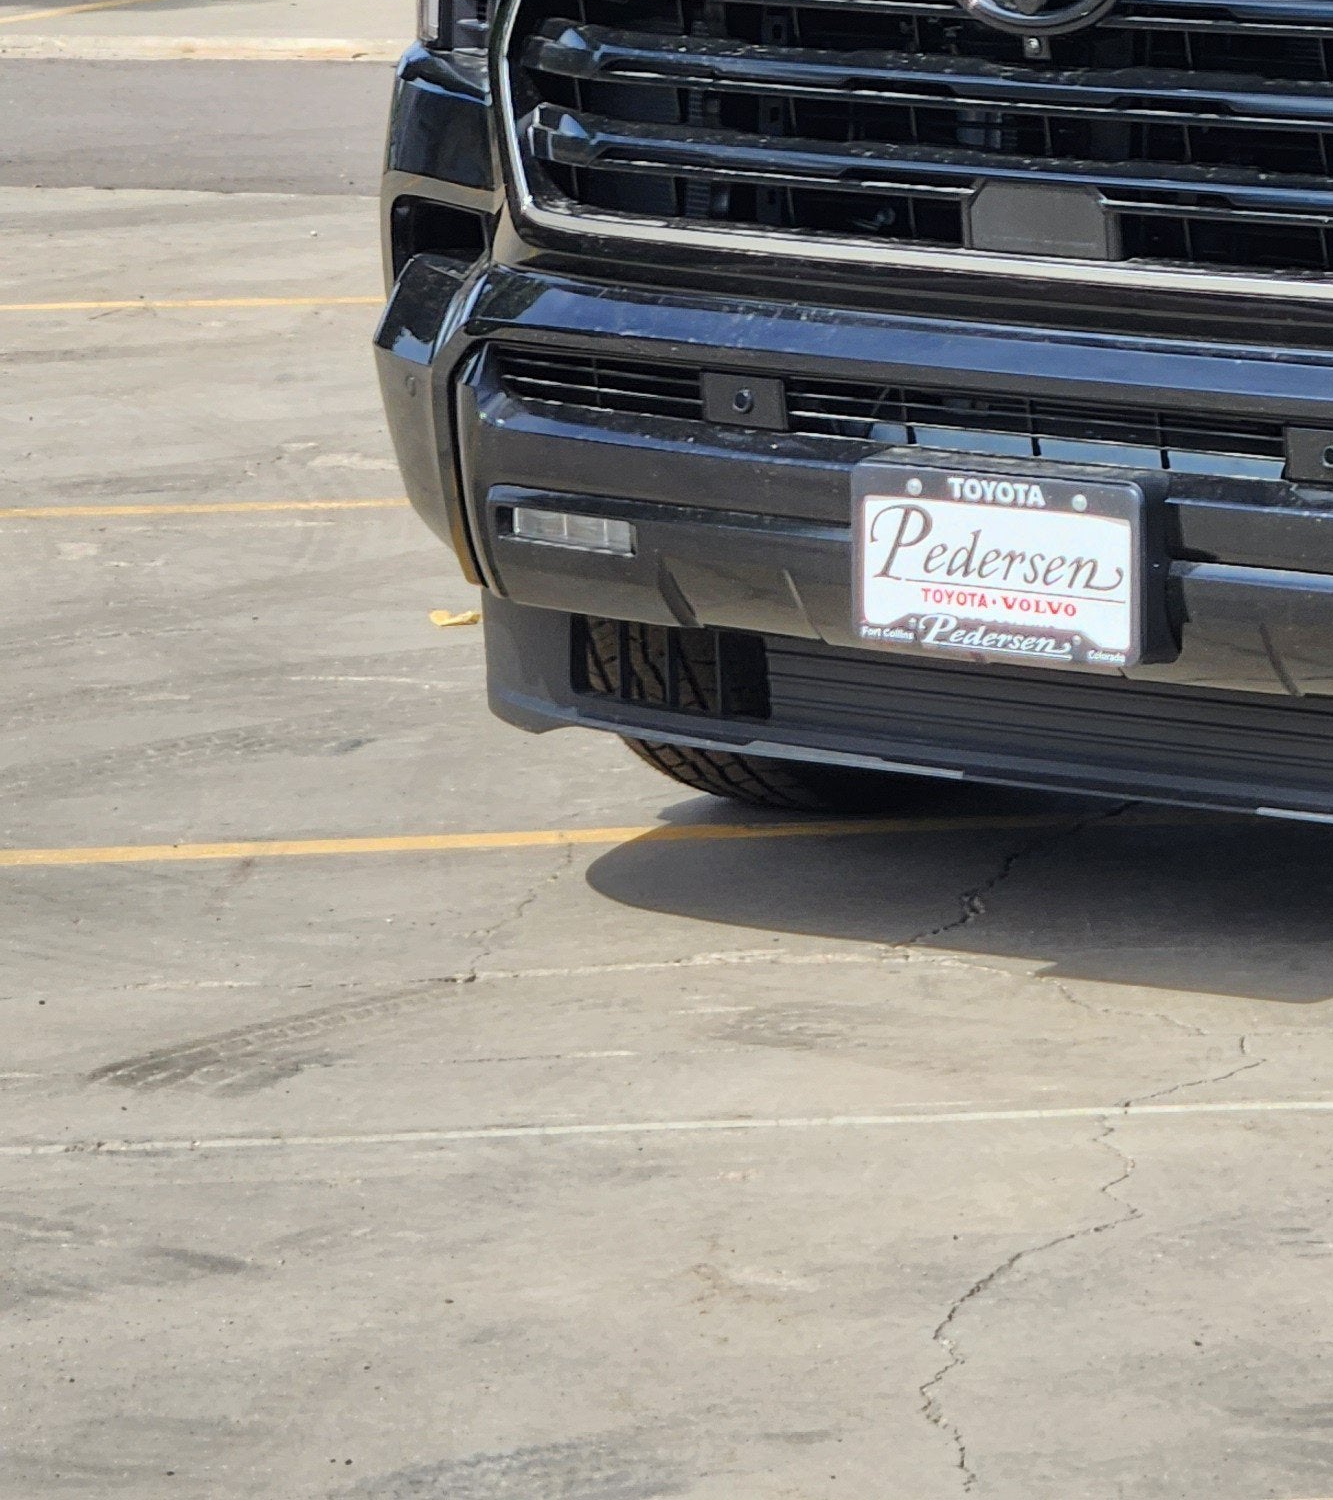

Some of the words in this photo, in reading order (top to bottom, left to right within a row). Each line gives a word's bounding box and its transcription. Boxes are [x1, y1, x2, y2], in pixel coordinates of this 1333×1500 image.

[948, 476, 1047, 508] TOYOTA
[869, 503, 1125, 592] Pedersen
[921, 587, 987, 609] TOYOTA
[1001, 595, 1078, 618] VOLVO
[918, 612, 1072, 654] Pedersen
